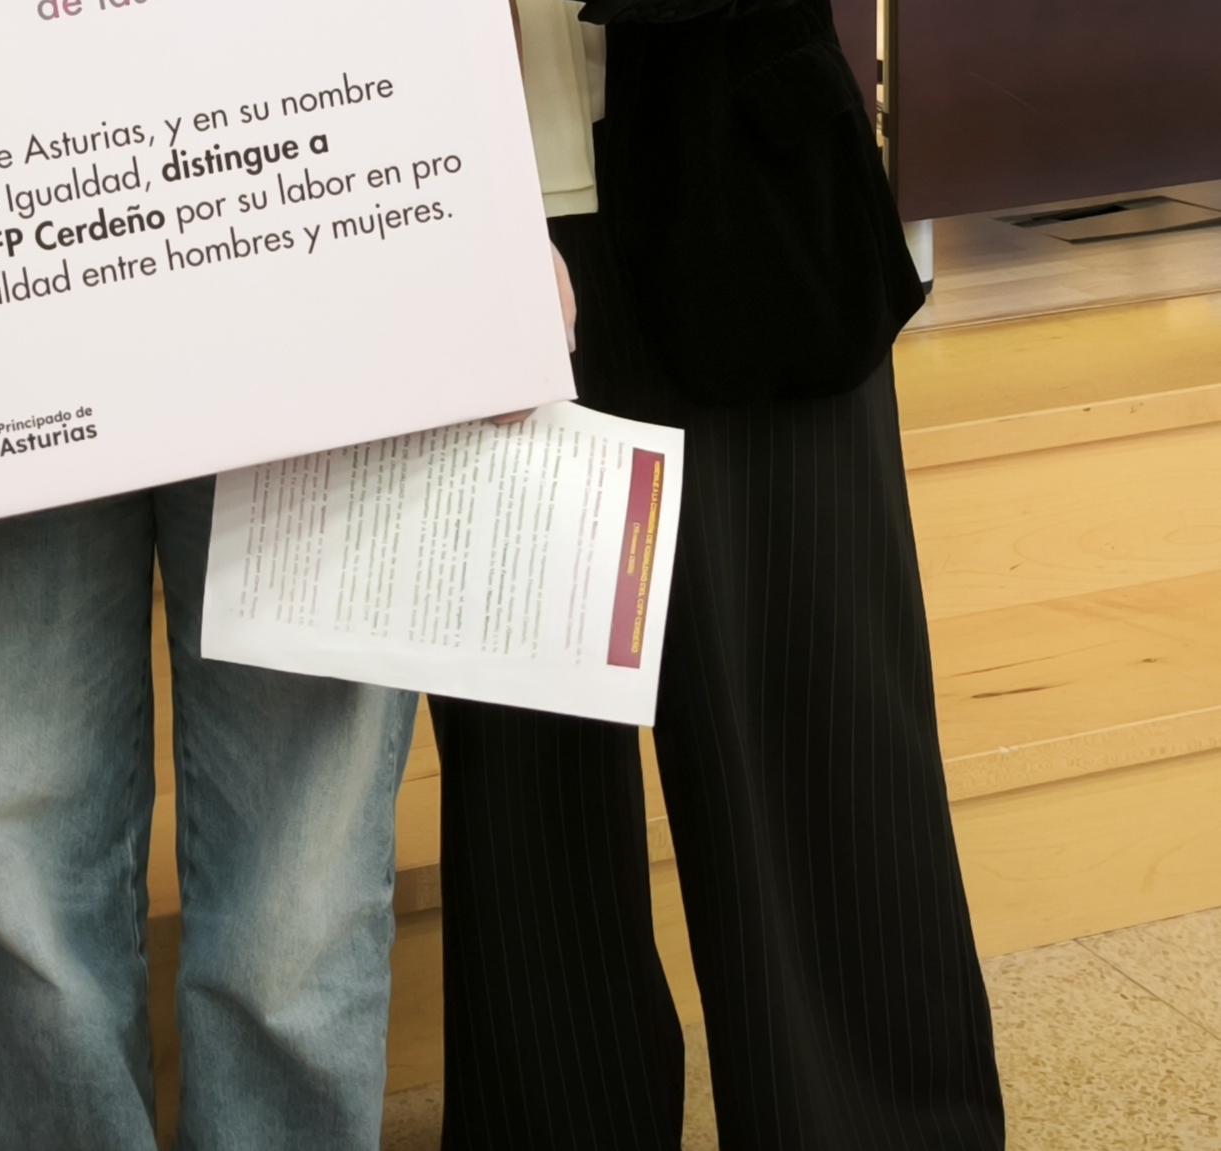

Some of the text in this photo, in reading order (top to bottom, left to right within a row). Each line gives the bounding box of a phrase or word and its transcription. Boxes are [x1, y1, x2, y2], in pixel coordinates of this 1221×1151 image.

[24, 120, 155, 165] Asturias,
[164, 117, 182, 147] y
[193, 109, 228, 132] en
[240, 101, 270, 124] su
[281, 72, 394, 116] nombre
[6, 155, 151, 219] Igualdad,
[162, 143, 299, 183] distingue
[309, 134, 329, 155] a
[35, 204, 165, 250] Cerdeño
[176, 195, 227, 234] por
[238, 191, 268, 213] su
[277, 168, 356, 205] labor
[367, 165, 401, 188] en
[412, 155, 462, 189] pro
[82, 255, 157, 287] entre
[165, 226, 294, 271] hombres
[303, 224, 320, 254] y
[332, 201, 453, 240] mujeres.
[0, 423, 98, 457] Asturias
[75, 405, 93, 419] de
